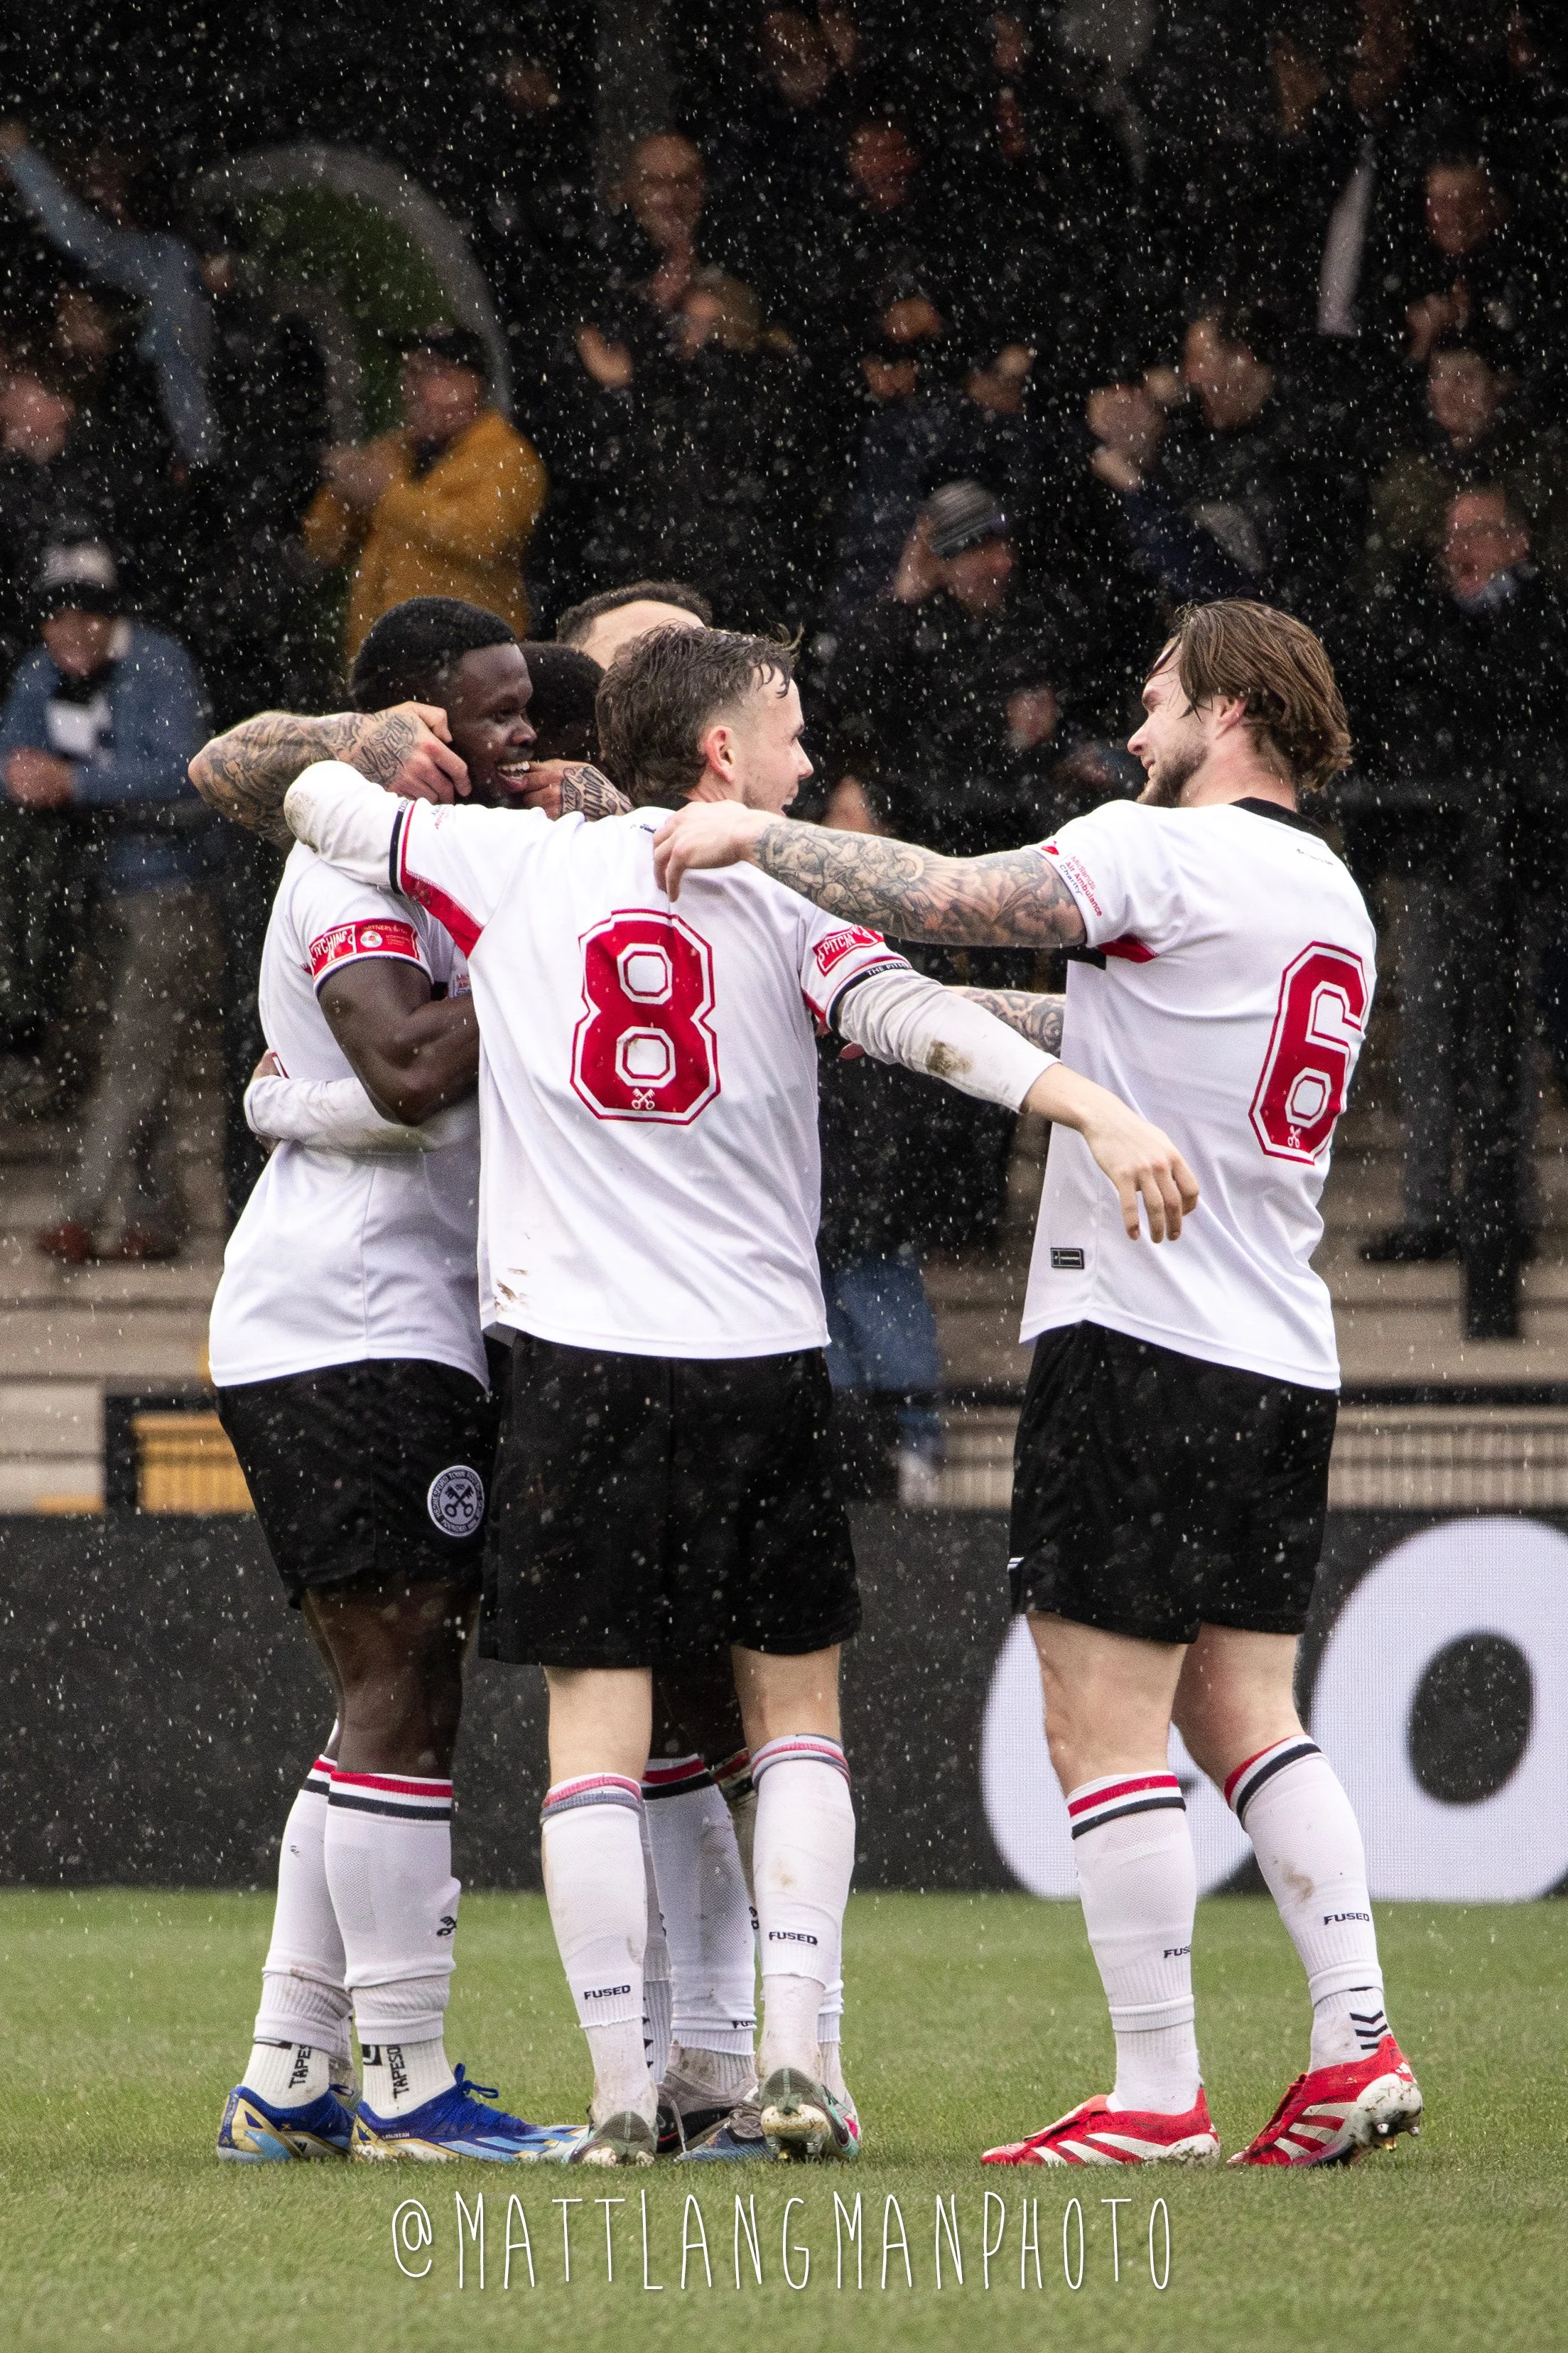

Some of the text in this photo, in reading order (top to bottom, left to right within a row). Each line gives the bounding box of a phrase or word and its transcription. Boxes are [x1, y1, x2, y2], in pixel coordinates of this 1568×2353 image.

[1059, 863, 1082, 894] Charity
[1071, 856, 1096, 890] Midlands
[1066, 861, 1103, 917] Air Ambulance
[867, 966, 884, 976] THE
[569, 908, 721, 1126] 8
[1248, 940, 1368, 1166] 6
[1323, 1912, 1370, 1925] FUSED
[768, 1931, 818, 1945] FUSED
[583, 1984, 631, 2000] FUSED
